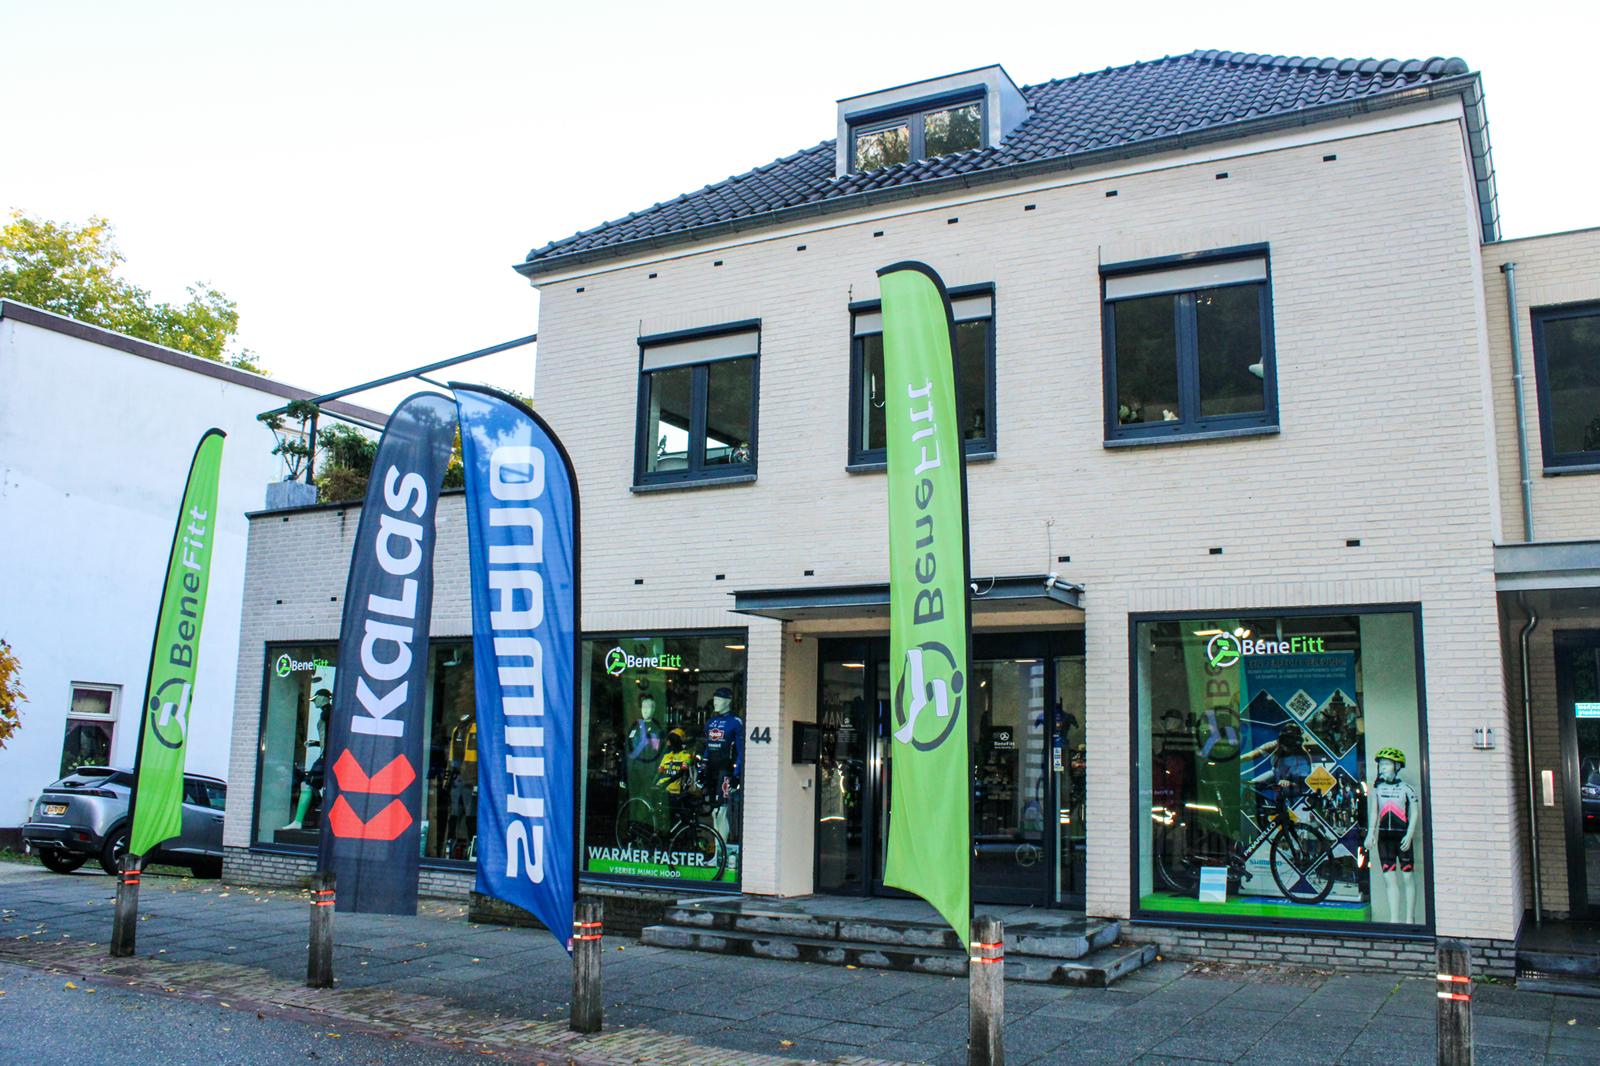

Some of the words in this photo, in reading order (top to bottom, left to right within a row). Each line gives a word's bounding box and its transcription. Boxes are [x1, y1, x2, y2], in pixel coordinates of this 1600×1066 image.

[169, 505, 208, 668] BeneFitt
[1242, 636, 1325, 655] BeneFitt
[627, 654, 682, 667] BeneFitt
[749, 726, 772, 744] 44
[588, 846, 650, 864] WARMER
[653, 851, 705, 867] FASTER
[614, 867, 636, 875] SERIES
[638, 868, 658, 876] MIMIC
[660, 869, 681, 878] HOOD
